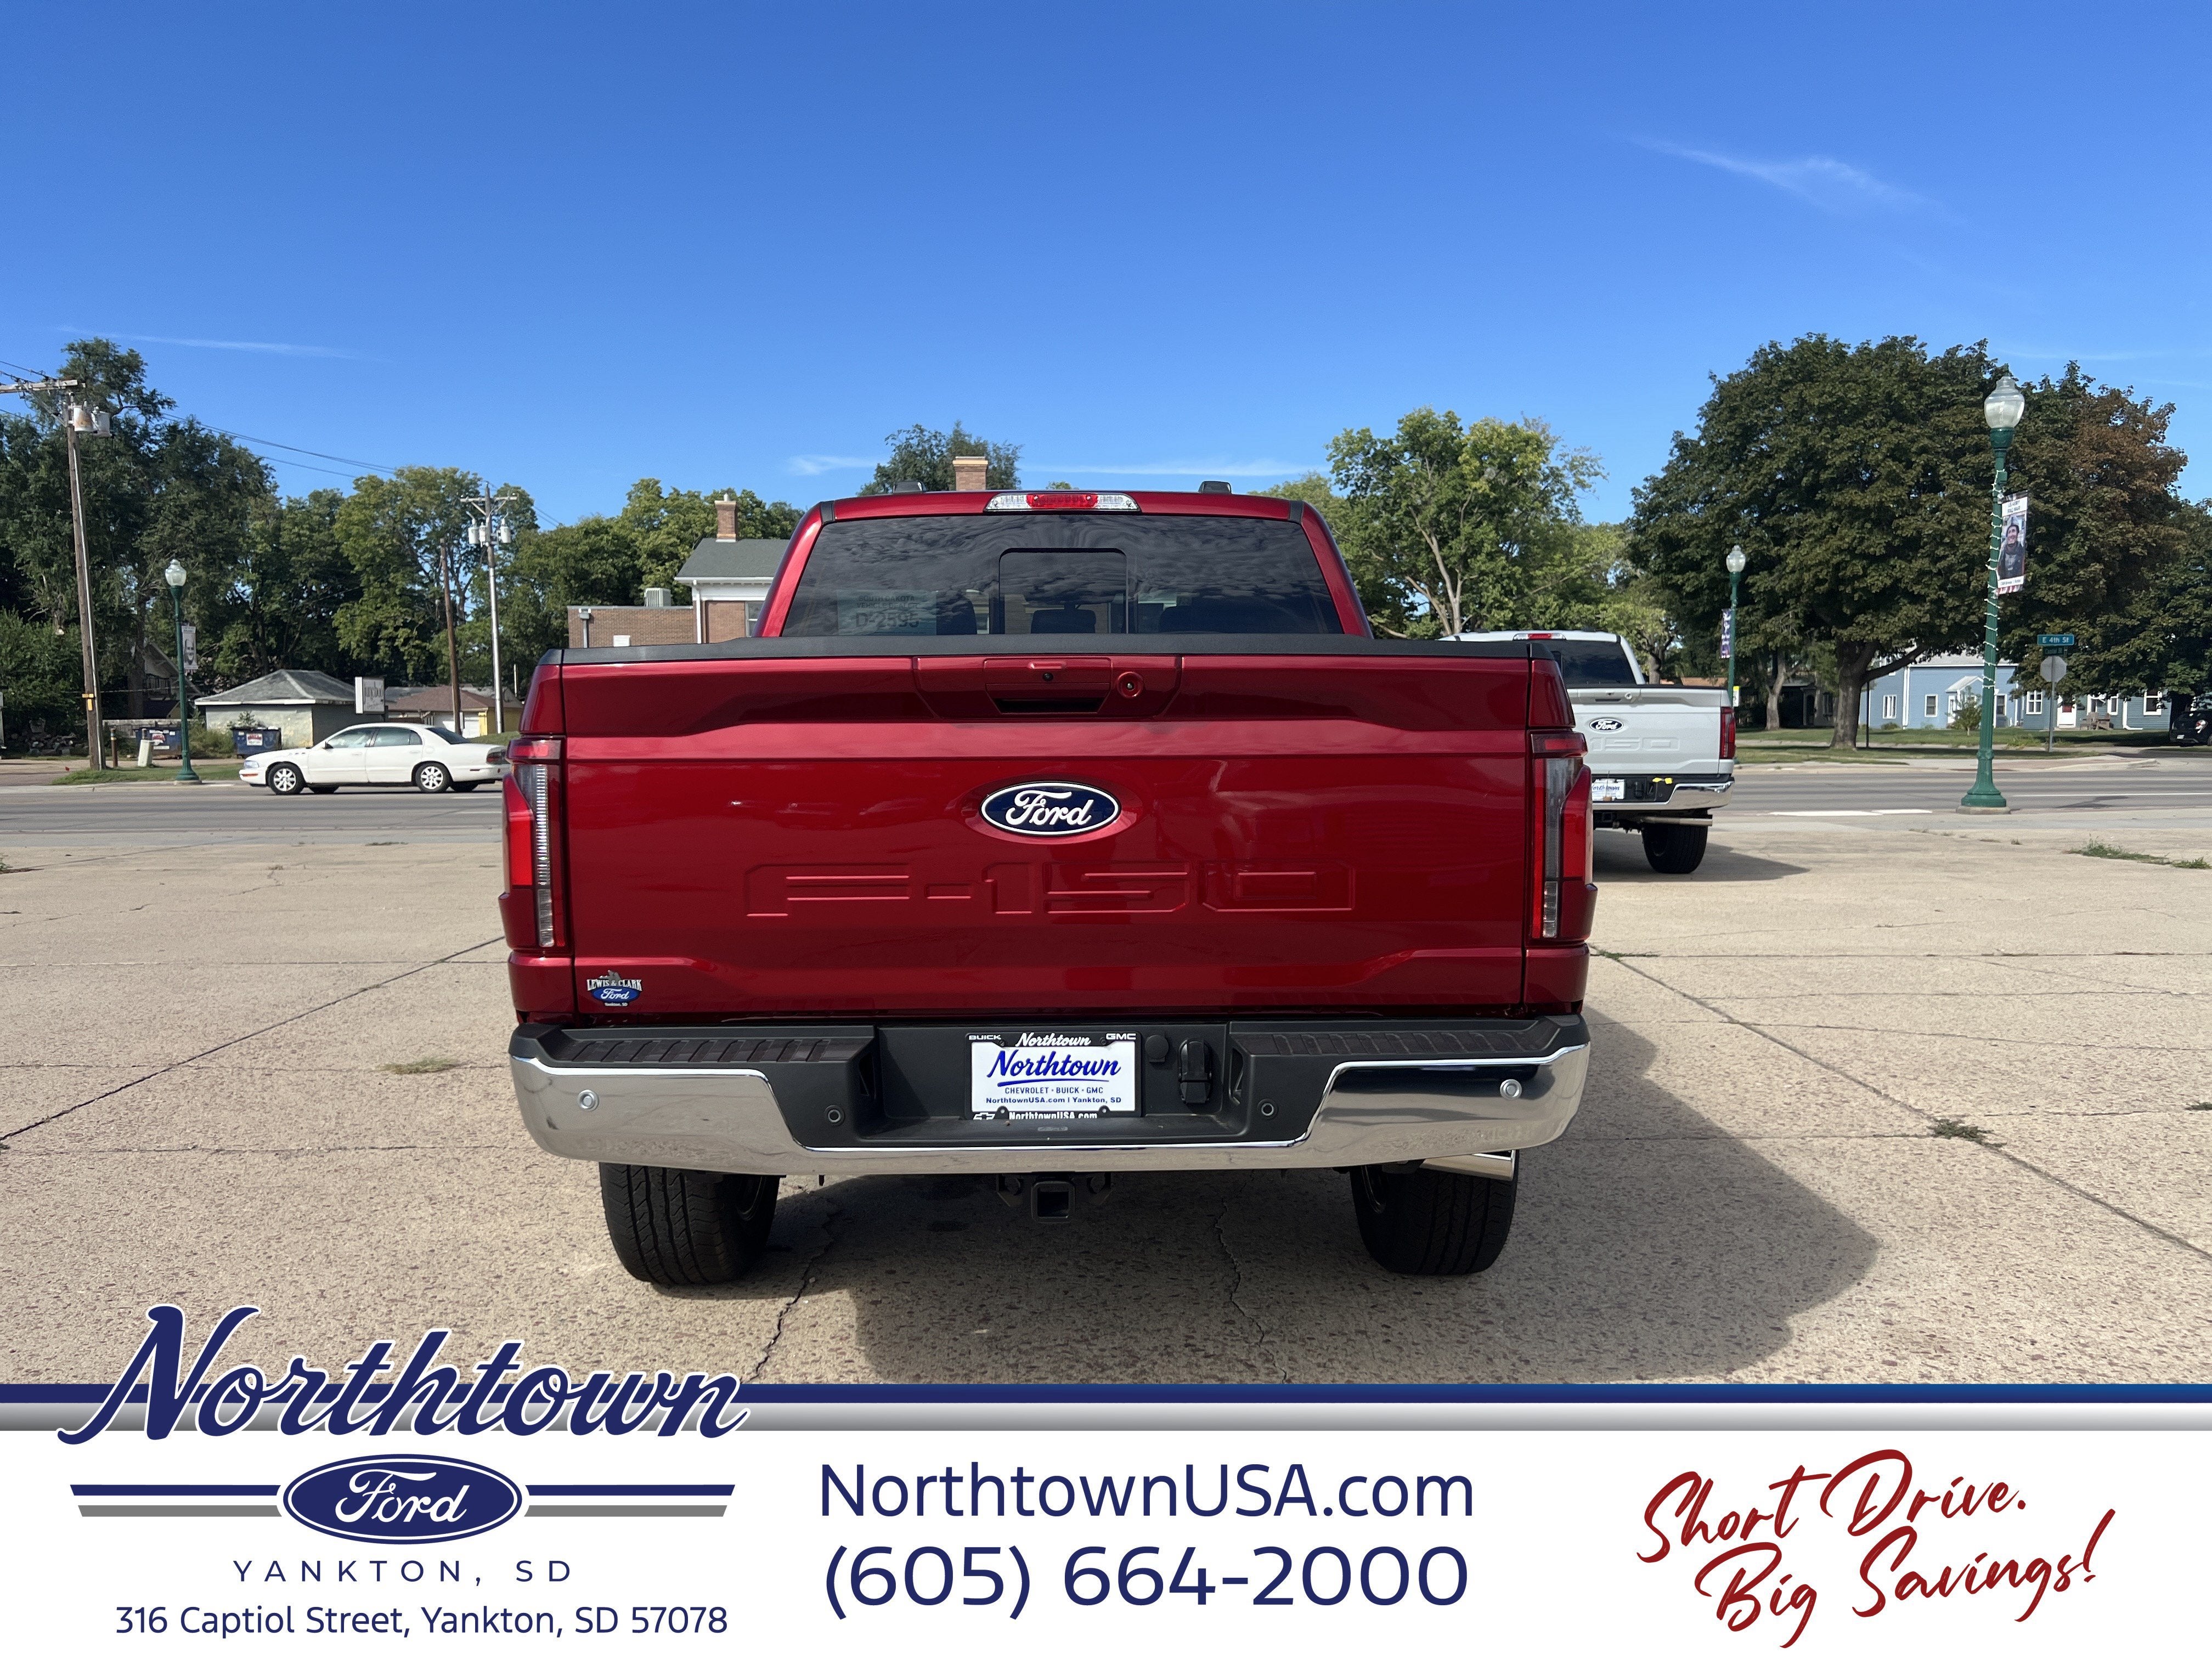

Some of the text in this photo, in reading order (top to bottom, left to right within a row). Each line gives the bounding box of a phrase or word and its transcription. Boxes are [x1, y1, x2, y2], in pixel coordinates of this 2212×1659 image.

[1595, 719, 1618, 730] Ford
[1005, 789, 1094, 826] Ford
[744, 859, 1356, 917] F-150
[586, 979, 610, 991] LEWIS
[618, 979, 643, 991] CLARK
[600, 988, 630, 1000] Ford
[1015, 1032, 1092, 1047] Northtown
[986, 1049, 1121, 1078] Northtown
